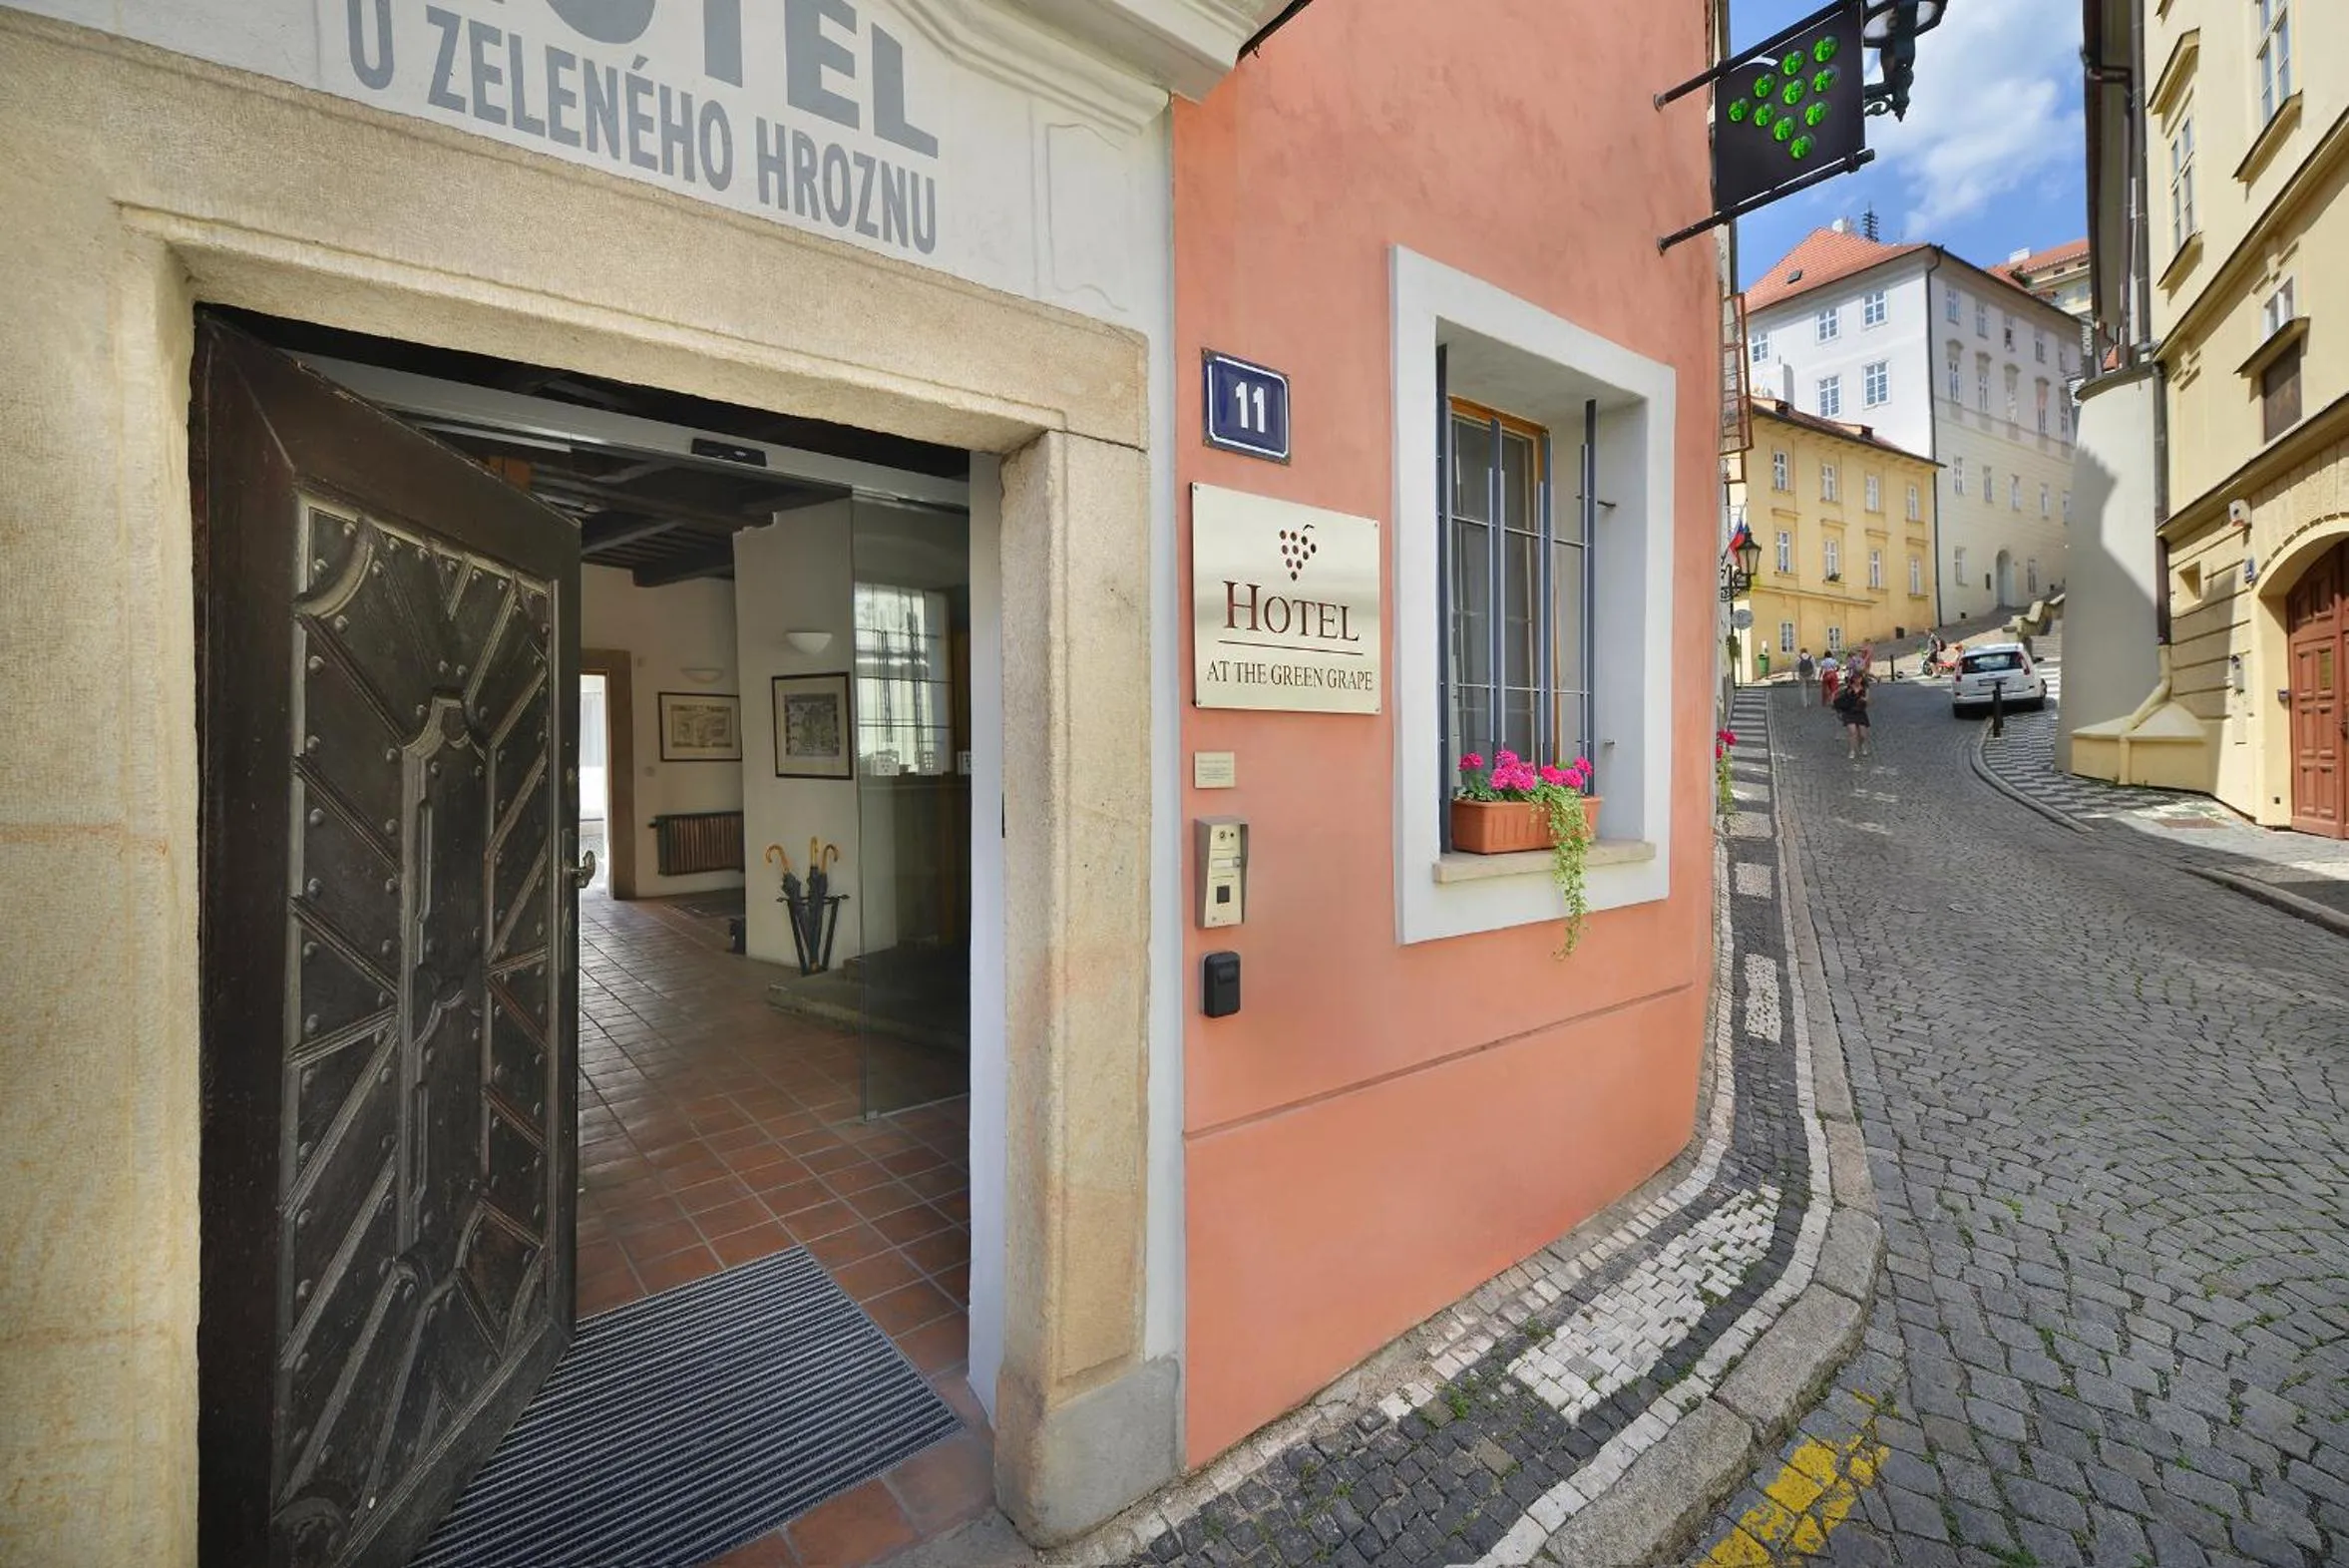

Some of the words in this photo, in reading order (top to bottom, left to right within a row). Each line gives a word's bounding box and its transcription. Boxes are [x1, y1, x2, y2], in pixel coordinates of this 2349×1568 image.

[347, 0, 394, 90] U
[426, 4, 733, 192] ZELENÉHO
[756, 117, 937, 254] HROZNU
[1236, 382, 1265, 433] 11
[1223, 581, 1360, 641] HOTEL
[1207, 659, 1230, 682] AT
[1234, 662, 1268, 685] THE
[1271, 664, 1324, 687] GREEN
[1327, 668, 1373, 691] GRAPE
